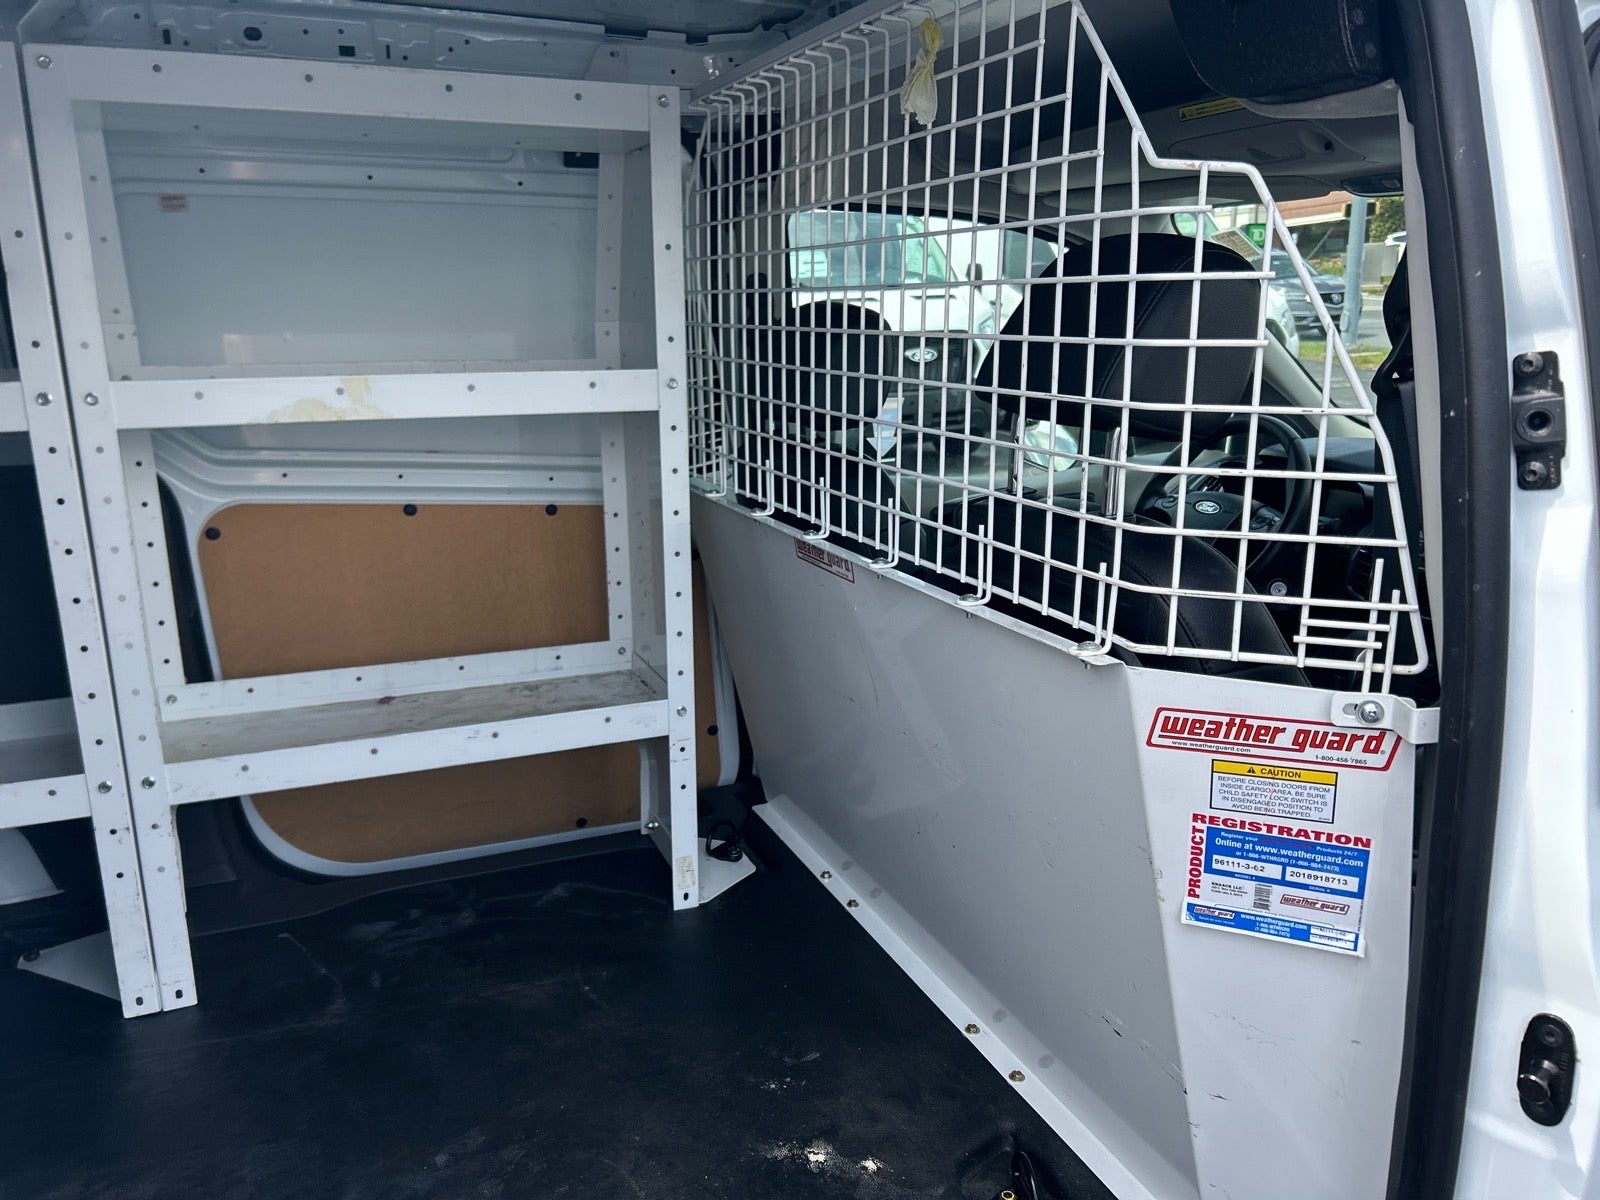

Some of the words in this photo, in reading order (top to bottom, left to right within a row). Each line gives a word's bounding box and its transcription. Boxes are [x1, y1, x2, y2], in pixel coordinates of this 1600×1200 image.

[1161, 716, 1286, 743] weather
[1292, 729, 1386, 754] guard
[1172, 740, 1251, 753] www.weatherguard.com
[1315, 755, 1367, 765] 1-800-4567865
[1260, 768, 1301, 778] CAUTION
[1248, 779, 1279, 787] CLOSING
[1230, 797, 1276, 806] DISENGAGED
[1278, 802, 1312, 811] POSITION
[1241, 791, 1268, 799] SAFETY
[1291, 797, 1319, 805] SWITCH
[1192, 813, 1371, 848] REGISTRATION
[1215, 838, 1242, 848] Online
[1255, 844, 1363, 867] www.weatherguard.com
[1188, 826, 1204, 898] PRODUCT
[1214, 859, 1265, 872] 96111-3-02
[1290, 871, 1348, 885] 2018918713
[1283, 896, 1318, 907] weather
[1320, 902, 1345, 911] guard
[1240, 914, 1307, 930] www.weatherguard.com
